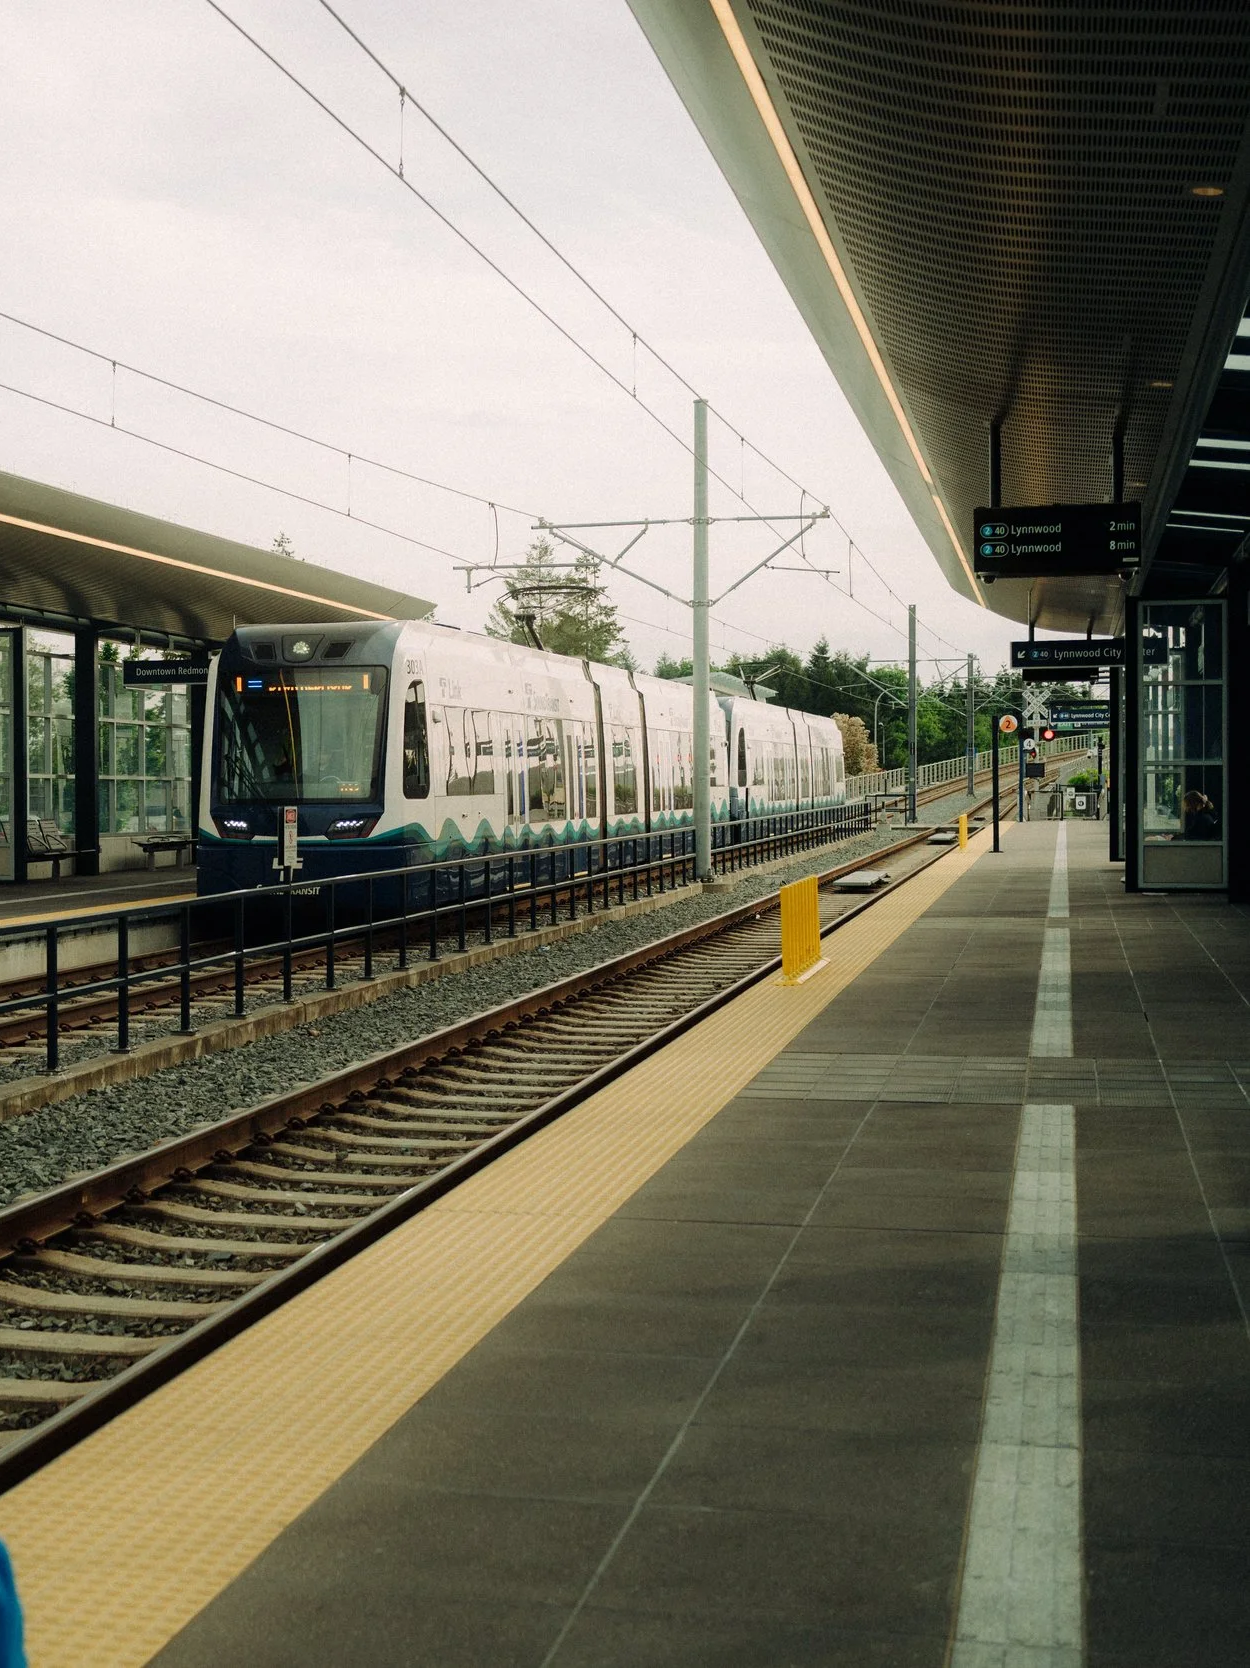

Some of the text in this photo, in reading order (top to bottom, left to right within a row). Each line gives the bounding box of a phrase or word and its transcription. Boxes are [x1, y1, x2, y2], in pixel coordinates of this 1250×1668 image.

[994, 527, 1005, 535] 40
[1011, 523, 1062, 537] Lynnwood
[1109, 521, 1116, 531] 2
[1117, 521, 1135, 531] min
[994, 545, 1005, 553] 40
[1011, 542, 1062, 556] Lynnwood
[1109, 541, 1116, 550] 8
[1117, 540, 1135, 550] min
[1054, 648, 1101, 662] Lynnwood
[1103, 647, 1122, 659] City
[136, 666, 209, 677] Downtown Redmon
[406, 659, 424, 675] 303A
[1006, 720, 1011, 729] 2
[1027, 740, 1032, 748] 4
